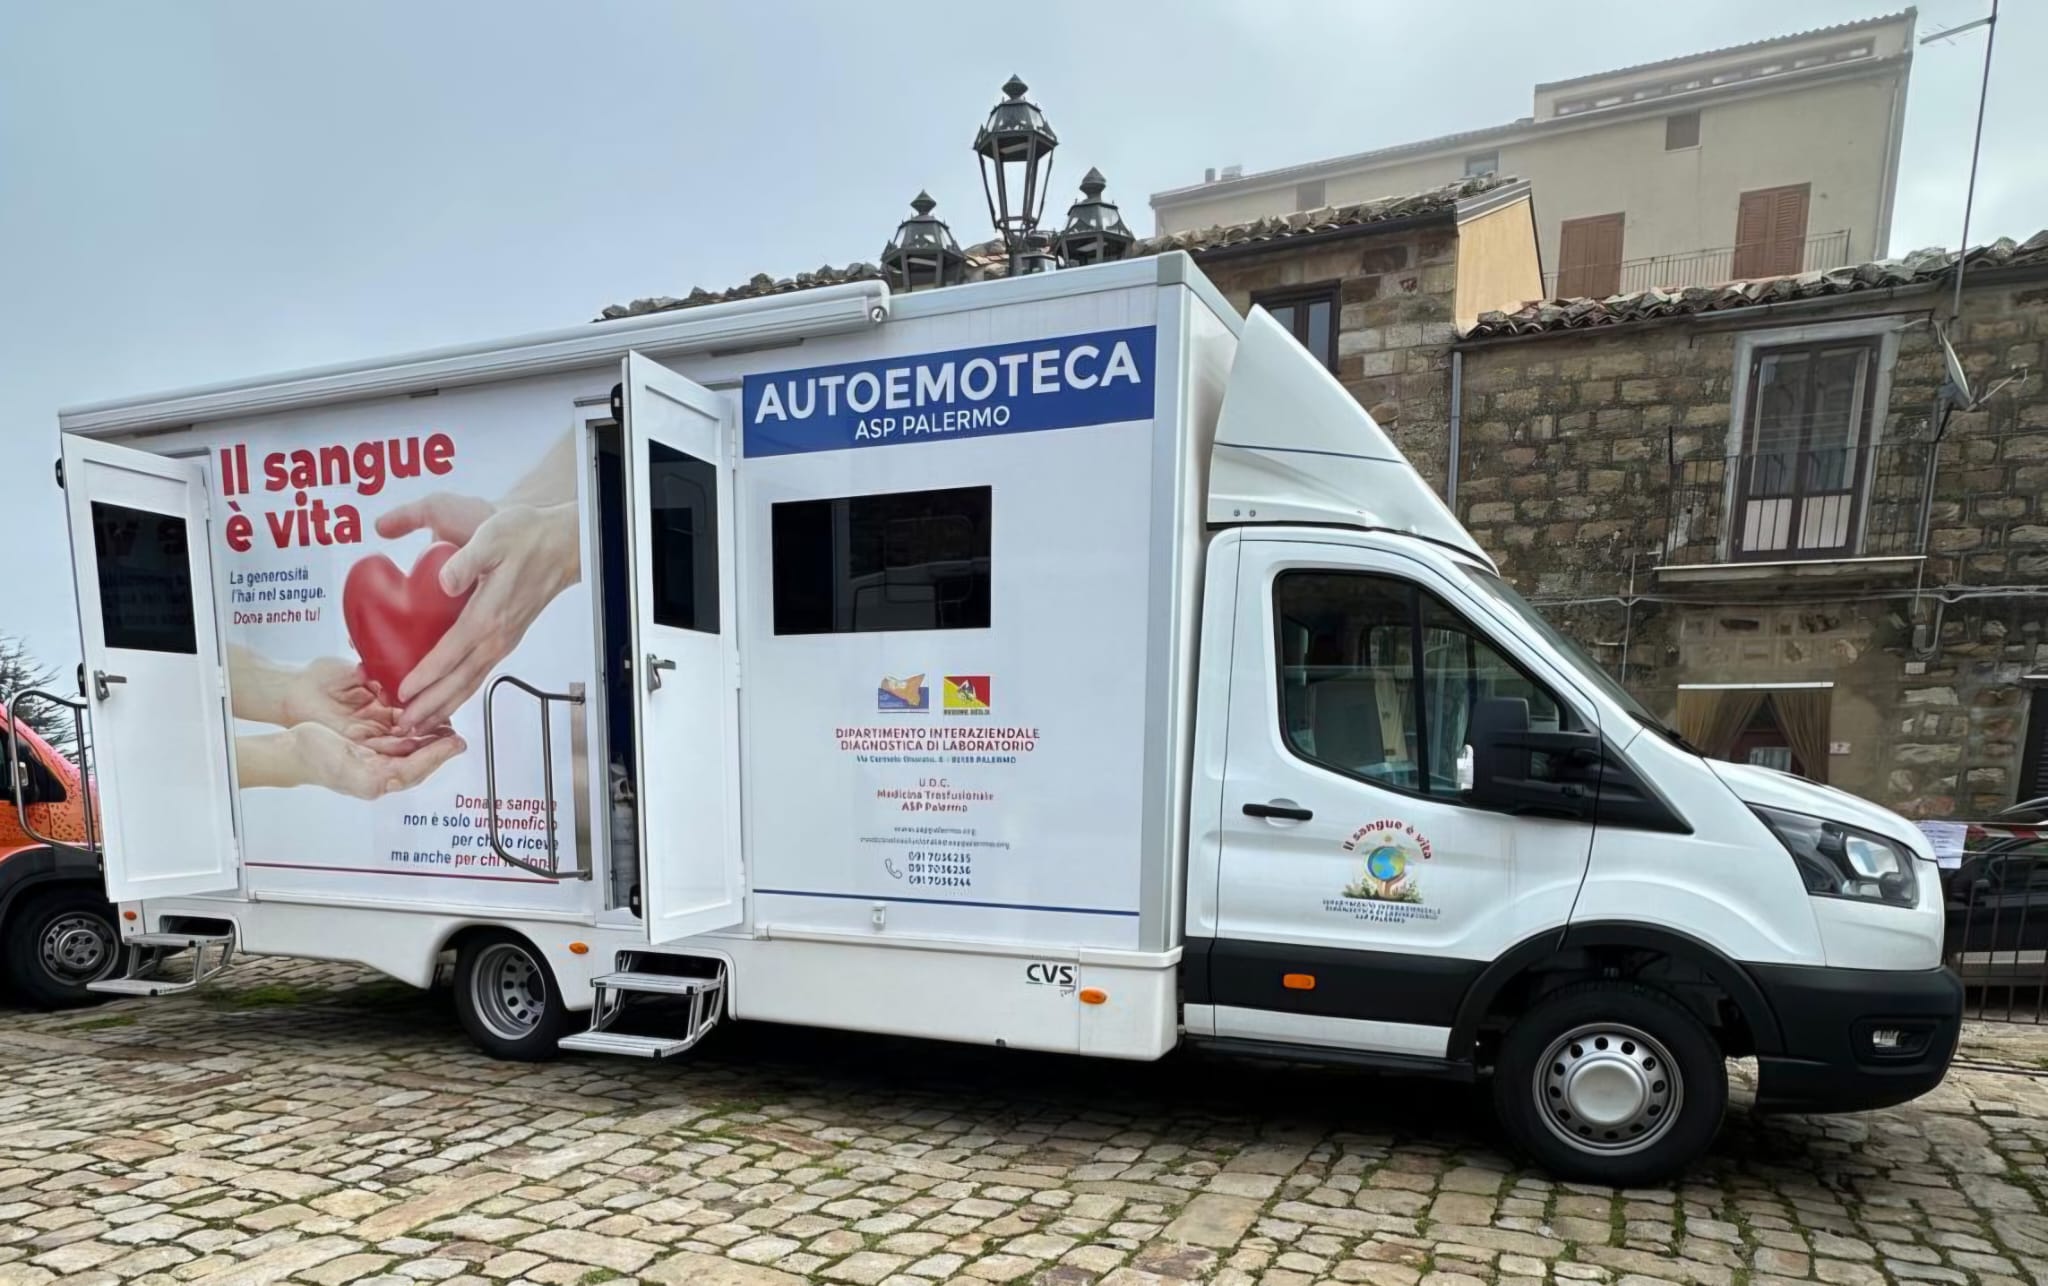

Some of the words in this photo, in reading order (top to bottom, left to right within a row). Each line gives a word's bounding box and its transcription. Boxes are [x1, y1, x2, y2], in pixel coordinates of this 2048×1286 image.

[755, 341, 1141, 424] AUTOEMOTECA
[855, 419, 896, 441] ASP
[903, 405, 1010, 436] PALERMO
[220, 444, 250, 496] Il
[263, 433, 455, 496] sangue
[226, 500, 253, 552] è
[265, 490, 362, 548] vita
[230, 570, 244, 585] La
[247, 565, 309, 587] generosità
[259, 587, 276, 601] nel
[279, 586, 326, 603] sangue.
[233, 611, 263, 625] Dona
[266, 609, 301, 623] anche
[836, 728, 926, 739] DIPARTIMENTO
[929, 728, 1040, 739] INTERAZIENDALE
[841, 740, 923, 751] DIAGNOSTICA
[927, 740, 939, 751] DI
[943, 740, 1034, 752] LABORATORIO
[456, 794, 502, 809] Donae
[901, 802, 922, 811] ASP
[925, 802, 968, 812] Palermo
[404, 814, 427, 826] non
[442, 813, 470, 827] solo
[496, 815, 557, 830] benefico
[452, 835, 473, 848] per
[477, 833, 497, 847] ch
[1353, 819, 1402, 841] sangue
[1416, 834, 1431, 859] vita
[391, 850, 409, 862] ma
[413, 850, 451, 863] anche
[455, 854, 477, 867] per
[481, 852, 500, 866] chi
[1027, 964, 1073, 984] CVS
